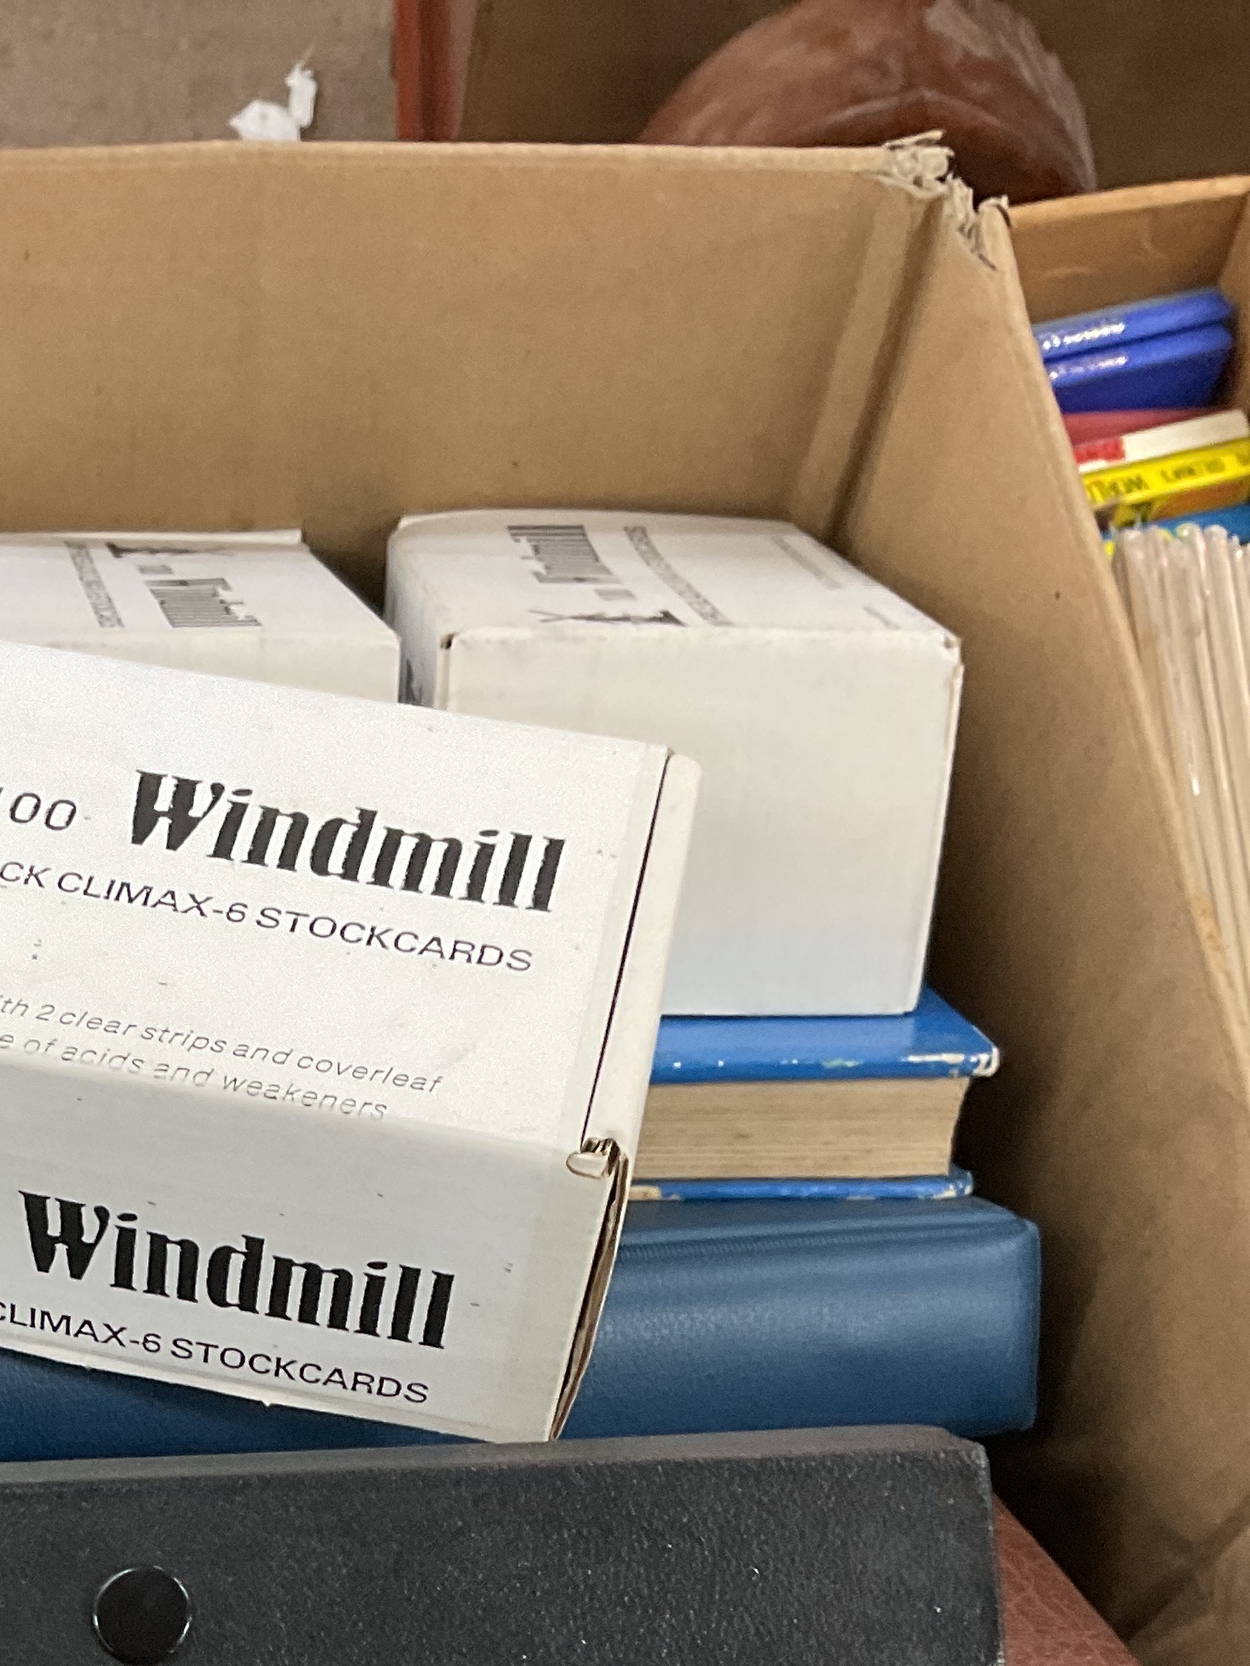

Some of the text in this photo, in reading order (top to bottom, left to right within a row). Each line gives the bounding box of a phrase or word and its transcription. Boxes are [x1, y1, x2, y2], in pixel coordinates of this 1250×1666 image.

[130, 769, 566, 912] Windmill
[57, 871, 249, 923] CLIMAX-6
[255, 907, 534, 972] STOCKCARDS
[23, 1037, 58, 1057] of
[61, 1045, 145, 1075] acids
[152, 1062, 215, 1088] and
[222, 1073, 389, 1121] weakeners
[35, 1003, 56, 1022] 2
[59, 1011, 138, 1036] clear
[140, 1026, 228, 1054] strips
[232, 1043, 294, 1066] and
[296, 1055, 444, 1094] coverleaf
[17, 1190, 456, 1350] Windmill
[170, 1338, 430, 1404] STOCKCARDS
